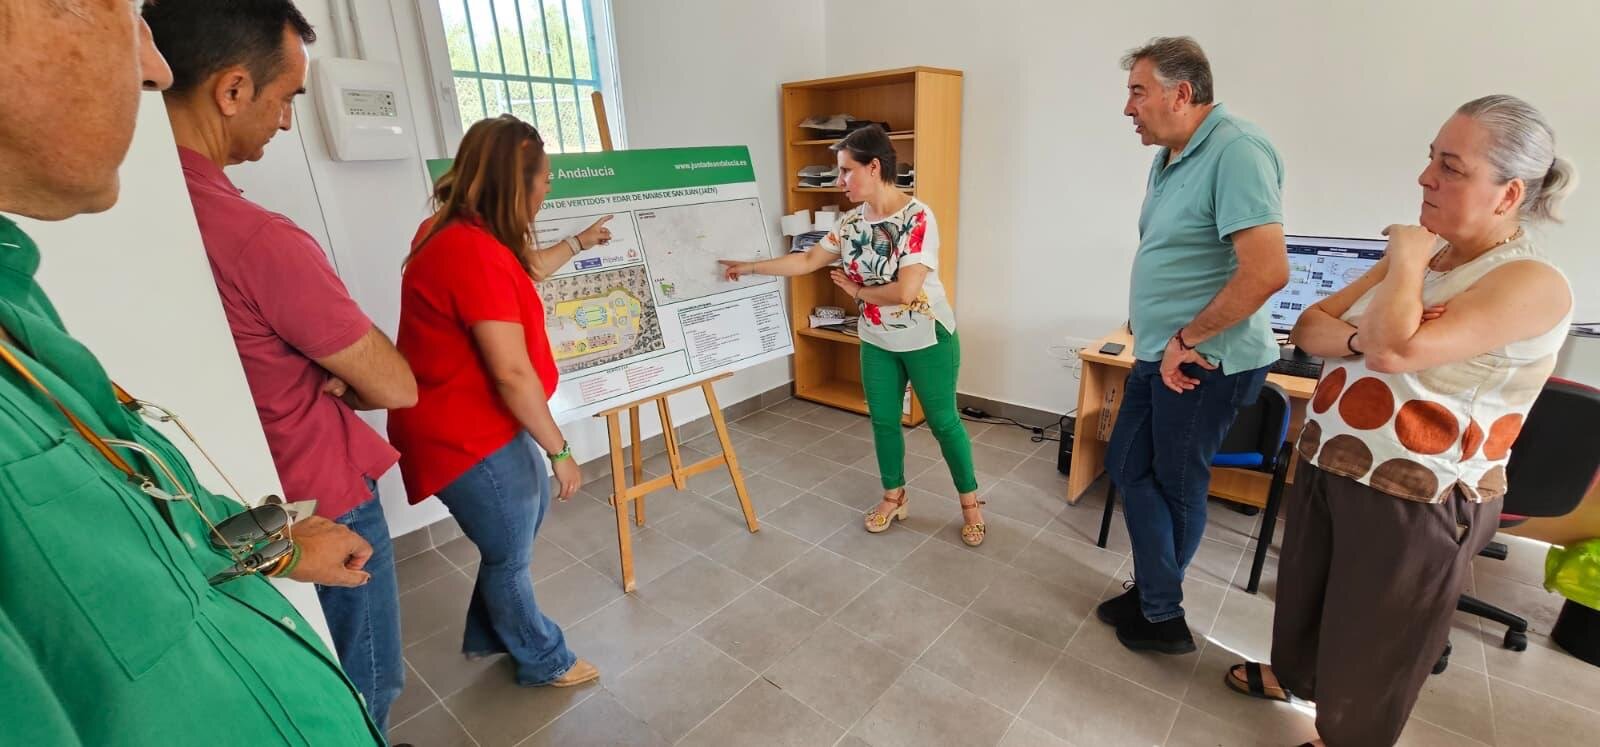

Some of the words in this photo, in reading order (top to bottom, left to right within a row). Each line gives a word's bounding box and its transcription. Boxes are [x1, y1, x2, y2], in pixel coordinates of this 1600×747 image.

[555, 200, 567, 208] DE
[568, 198, 604, 208] VERTIDOS
[612, 194, 631, 203] EDAR
[632, 192, 642, 201] DE
[642, 190, 664, 200] NAVAS
[663, 190, 672, 198] DE
[672, 189, 684, 197] SAN
[684, 188, 699, 196] JUAN
